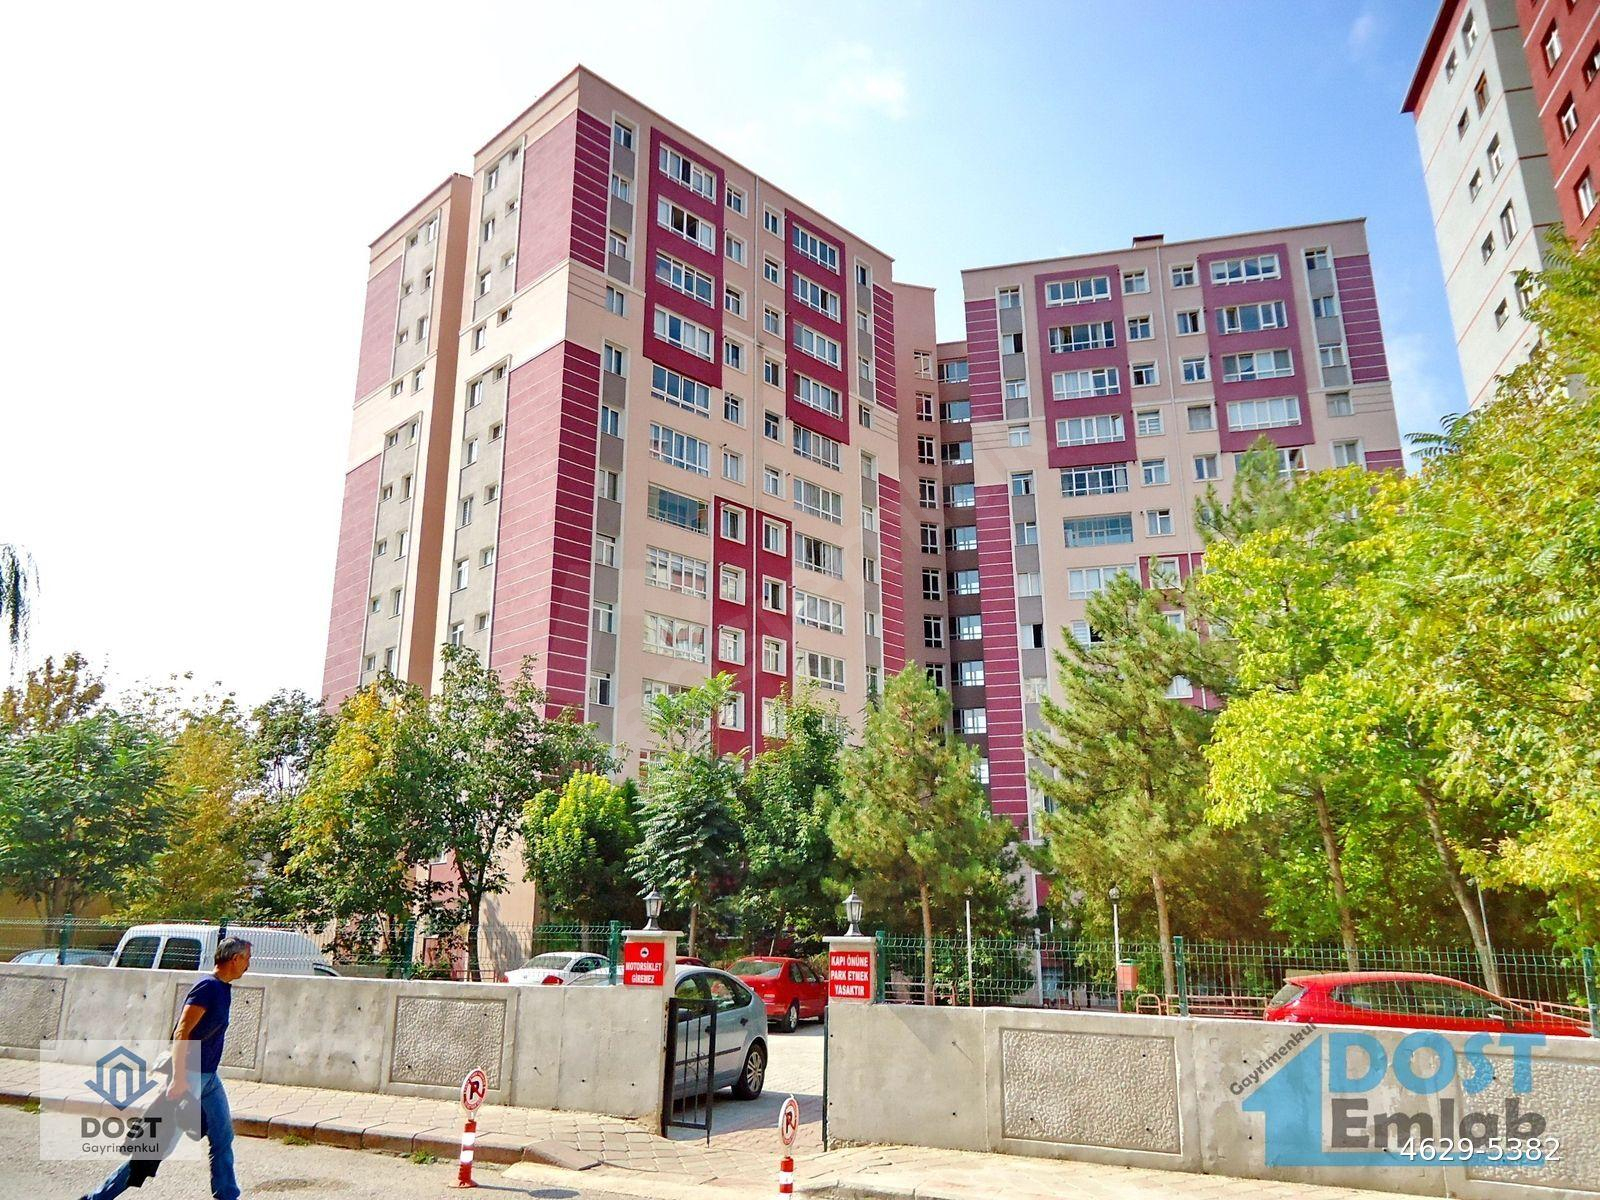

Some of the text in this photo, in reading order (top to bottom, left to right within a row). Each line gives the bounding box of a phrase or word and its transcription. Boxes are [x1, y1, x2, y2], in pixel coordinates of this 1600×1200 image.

[831, 954, 869, 967] KAPI ÖNÜNE
[830, 970, 869, 981] PARK ETMEK
[835, 985, 865, 996] YASAKTIR
